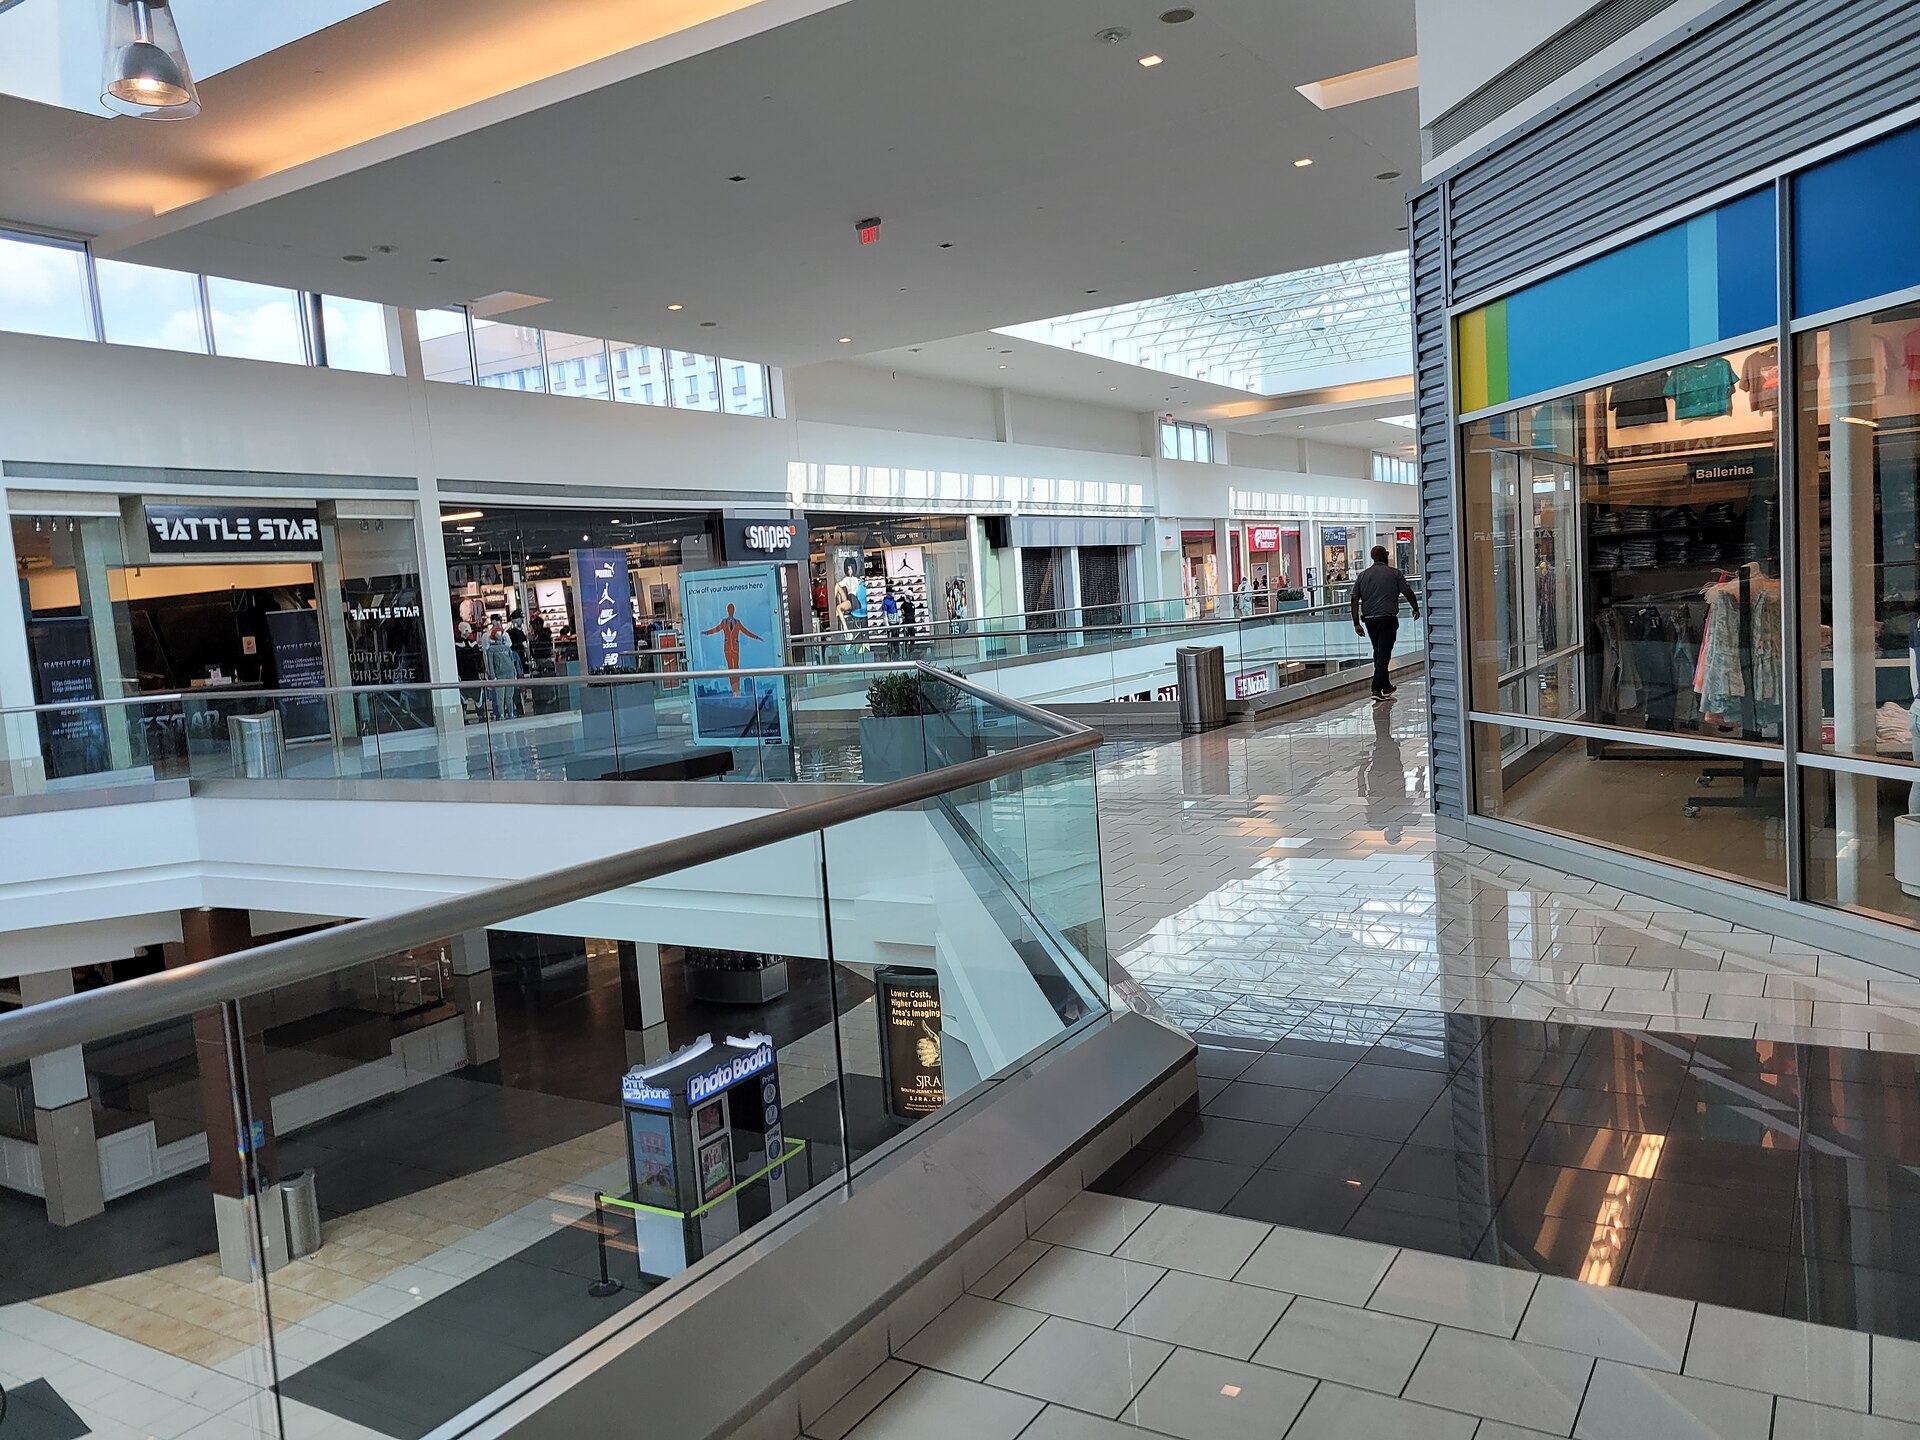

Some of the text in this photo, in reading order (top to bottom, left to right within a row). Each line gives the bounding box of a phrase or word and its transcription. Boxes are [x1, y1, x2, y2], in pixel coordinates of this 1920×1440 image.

[1695, 465, 1754, 479] Ballerina
[150, 517, 319, 541] BATTLE STAR
[748, 525, 792, 553] snipes
[688, 587, 701, 596] show
[709, 586, 722, 595] your
[722, 583, 748, 592] business
[350, 605, 420, 620] BATTLE STAR
[890, 989, 931, 999] Lower Costs,
[891, 998, 940, 1008] Higher Quality.
[892, 1008, 941, 1018] Area's Imaging
[892, 1017, 915, 1026] Leader.
[690, 1045, 772, 1100] Photo Booth
[761, 1073, 775, 1085] Print
[622, 1076, 645, 1089] Print
[916, 1075, 942, 1089] SJRA
[640, 1087, 670, 1102] phone
